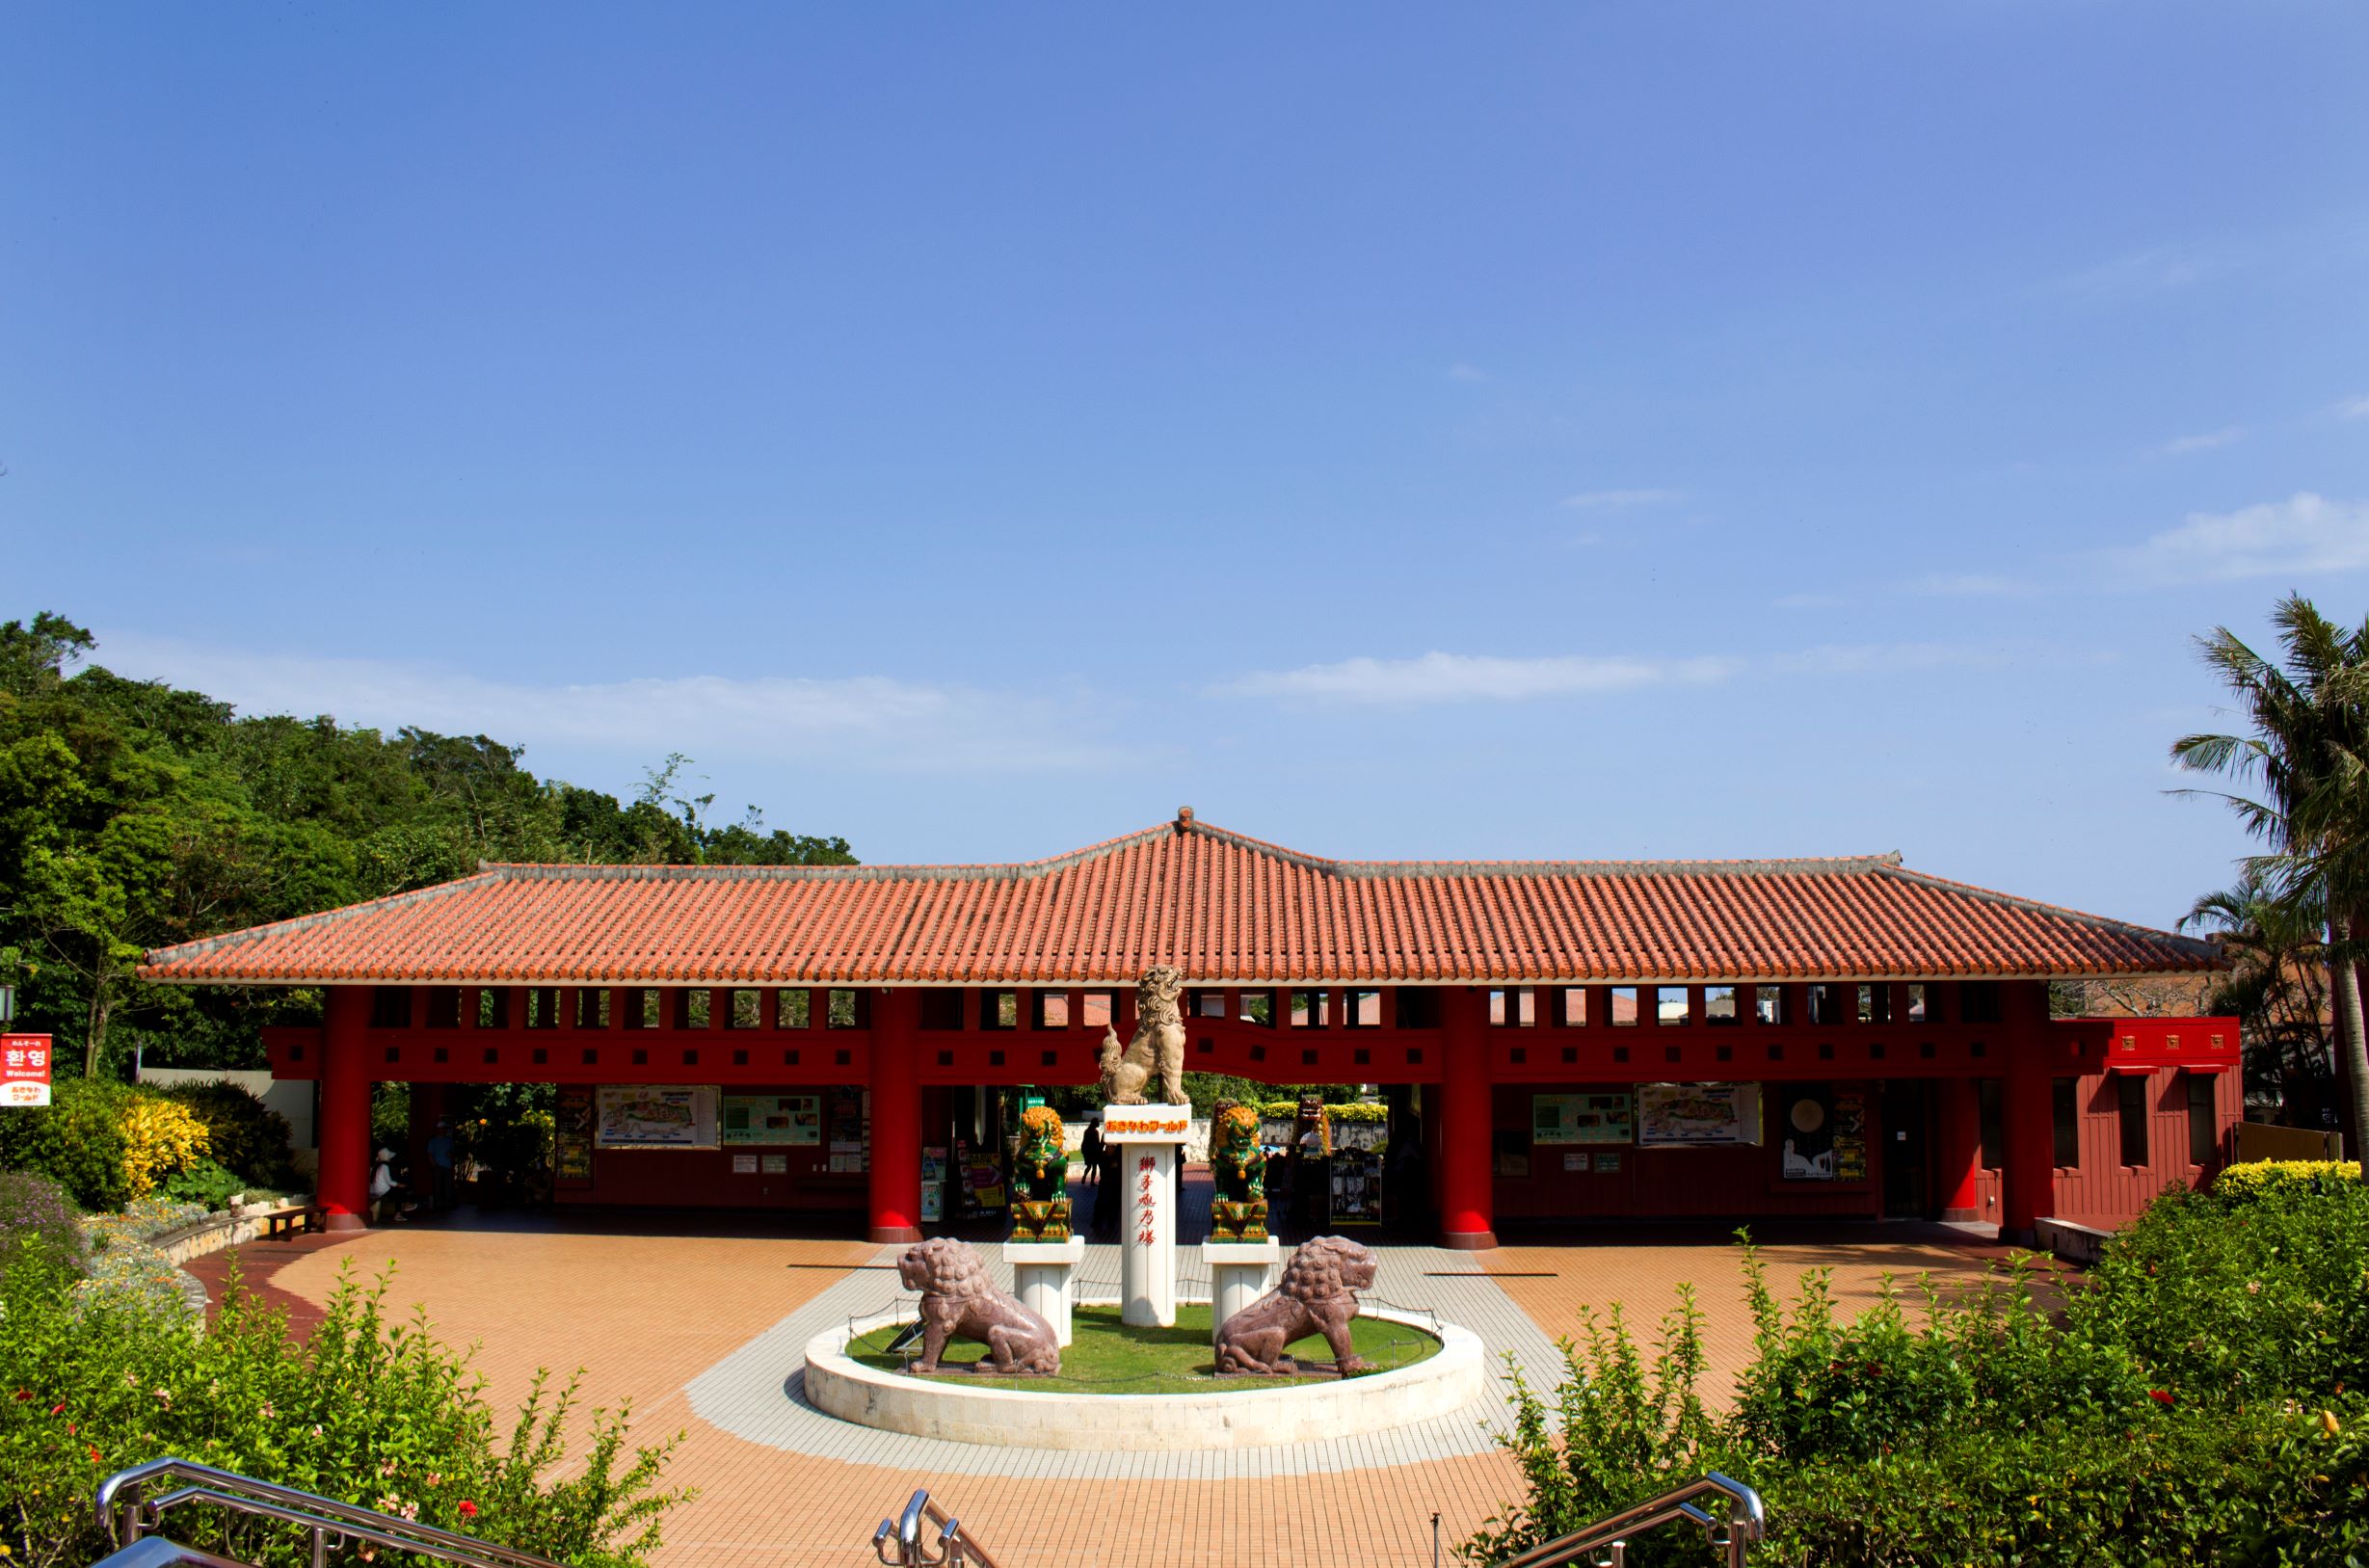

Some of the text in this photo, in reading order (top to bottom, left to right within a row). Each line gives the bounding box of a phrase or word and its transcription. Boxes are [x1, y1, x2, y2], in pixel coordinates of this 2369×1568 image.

[6, 1050, 46, 1067] 환영
[1105, 1120, 1188, 1133] おきなわワールド
